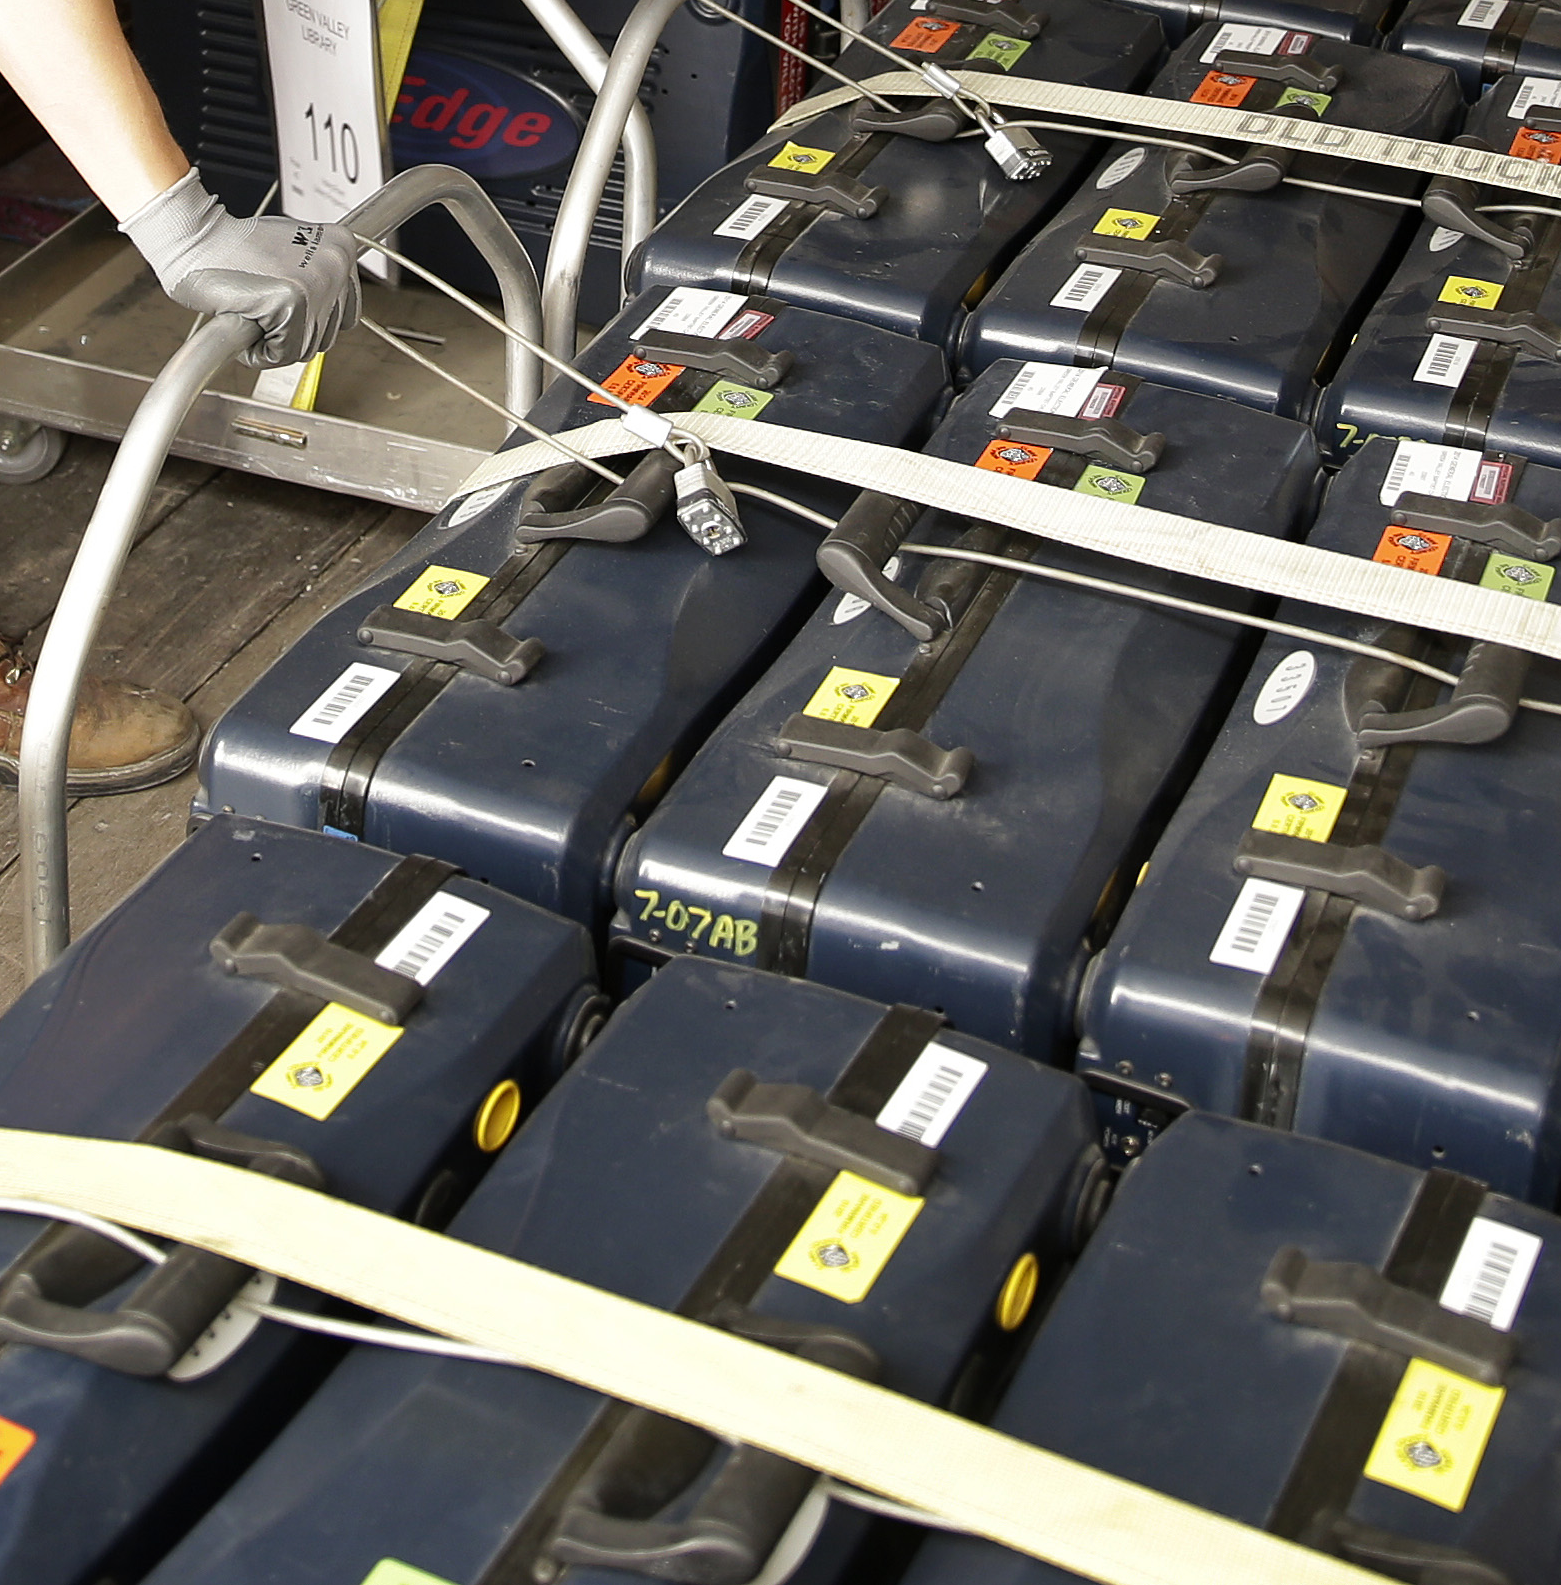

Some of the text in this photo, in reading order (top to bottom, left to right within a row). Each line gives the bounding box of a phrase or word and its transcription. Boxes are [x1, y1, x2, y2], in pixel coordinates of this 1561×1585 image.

[301, 24, 337, 56] LIBRARY
[315, 10, 351, 40] VALLEY
[305, 102, 359, 185] 110
[392, 75, 552, 150] Edge
[634, 889, 759, 956] 7-07AB
